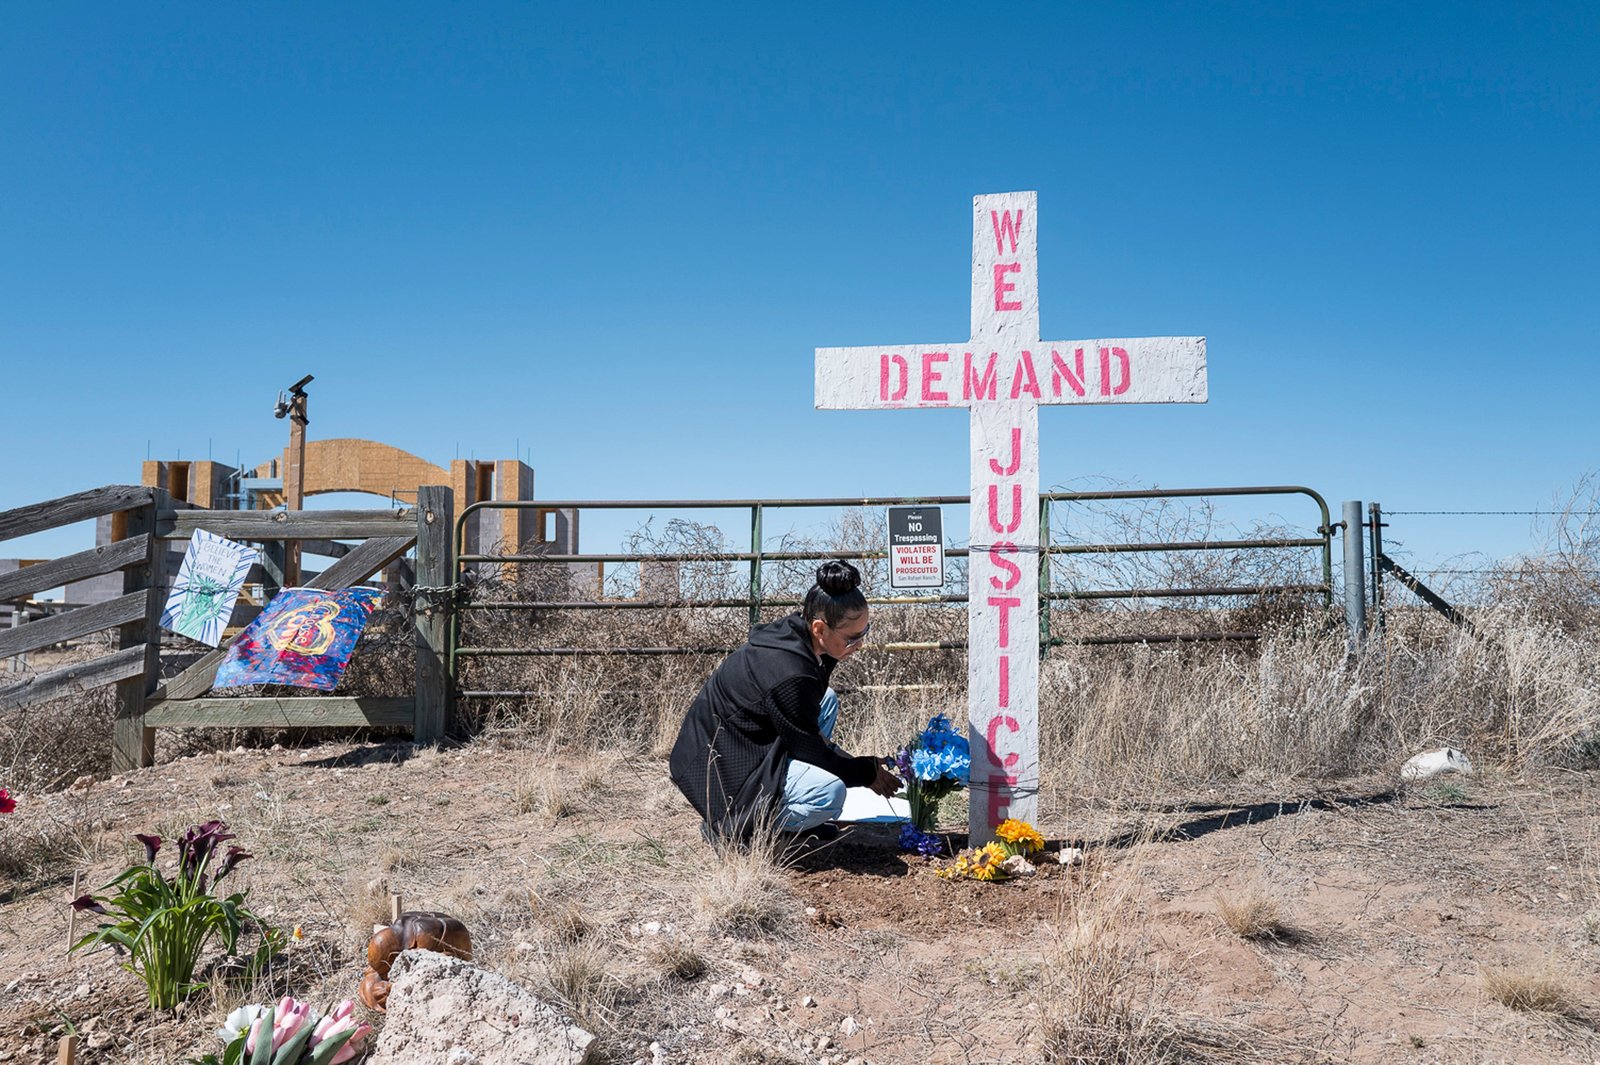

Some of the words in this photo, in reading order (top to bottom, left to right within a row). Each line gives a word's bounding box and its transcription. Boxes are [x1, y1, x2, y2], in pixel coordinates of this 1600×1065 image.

[990, 209, 1023, 312] WE
[880, 347, 1131, 403] DEMAND
[908, 522, 923, 532] NO
[894, 534, 938, 543] Trespassing
[203, 542, 237, 560] BELIEVE
[896, 546, 937, 554] VIOLATERS
[208, 554, 222, 566] THE
[900, 556, 920, 564] WILL
[922, 555, 933, 564] BE
[195, 560, 227, 577] WOMEN
[987, 427, 1023, 826] JUSTICE
